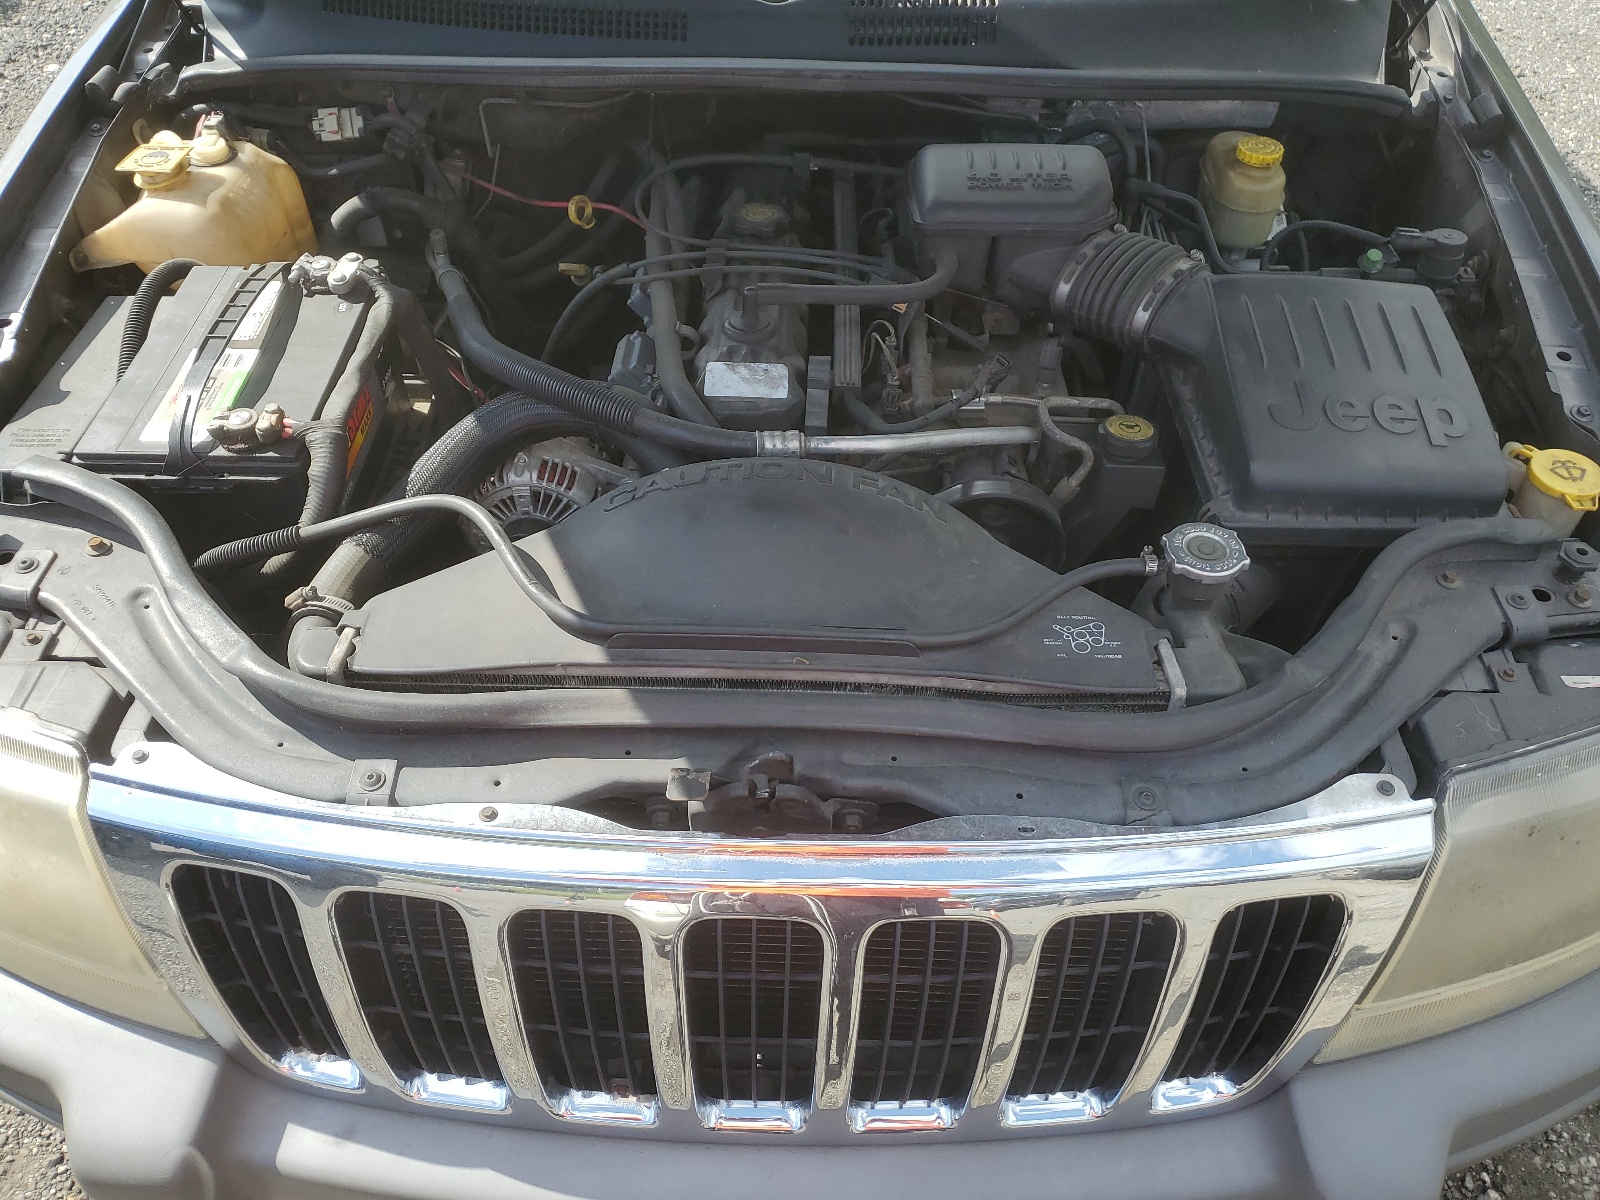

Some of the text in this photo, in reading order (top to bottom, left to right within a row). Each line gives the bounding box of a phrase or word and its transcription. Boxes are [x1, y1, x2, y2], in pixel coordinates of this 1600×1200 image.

[1267, 379, 1471, 448] Jeep
[603, 459, 949, 525] CAUTION FAN
